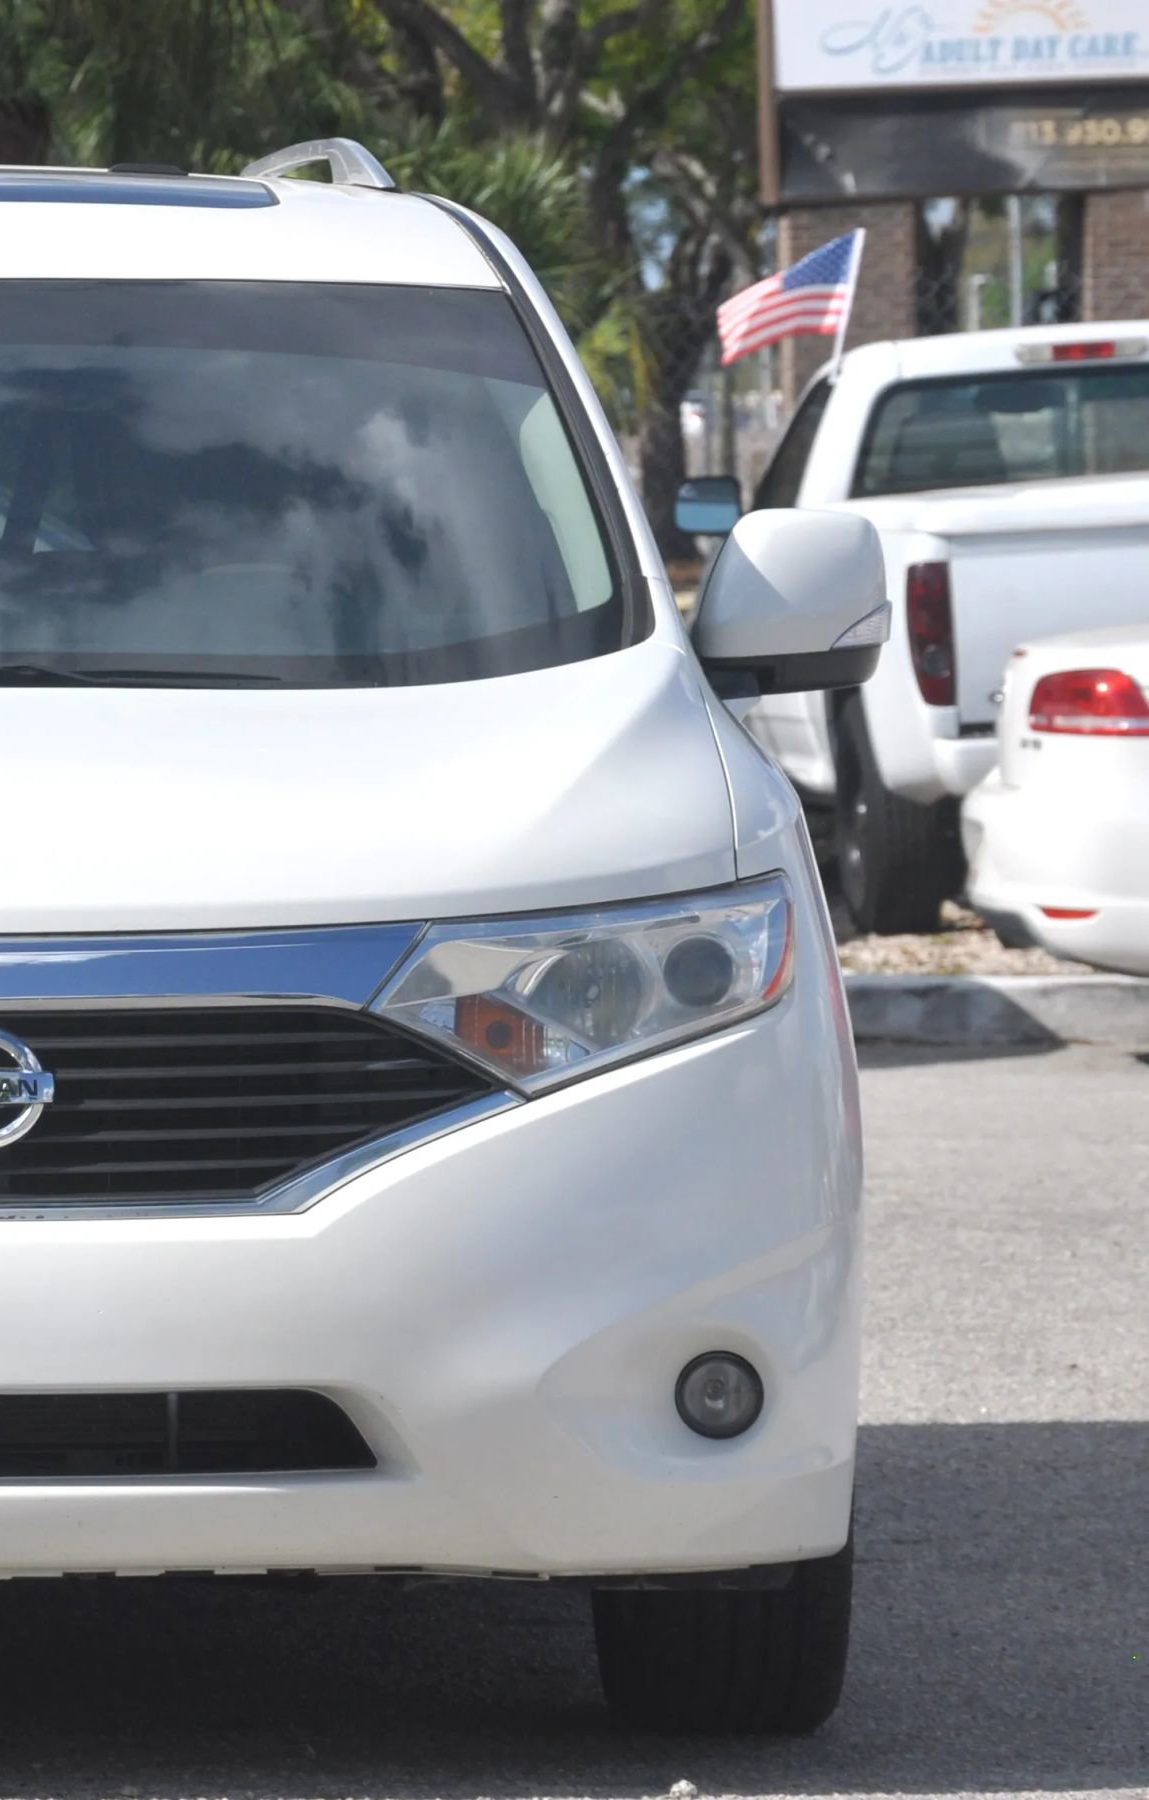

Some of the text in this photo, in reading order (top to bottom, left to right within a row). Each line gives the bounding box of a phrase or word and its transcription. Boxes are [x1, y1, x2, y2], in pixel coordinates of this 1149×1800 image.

[920, 31, 1139, 64] ADULT DAY CARE
